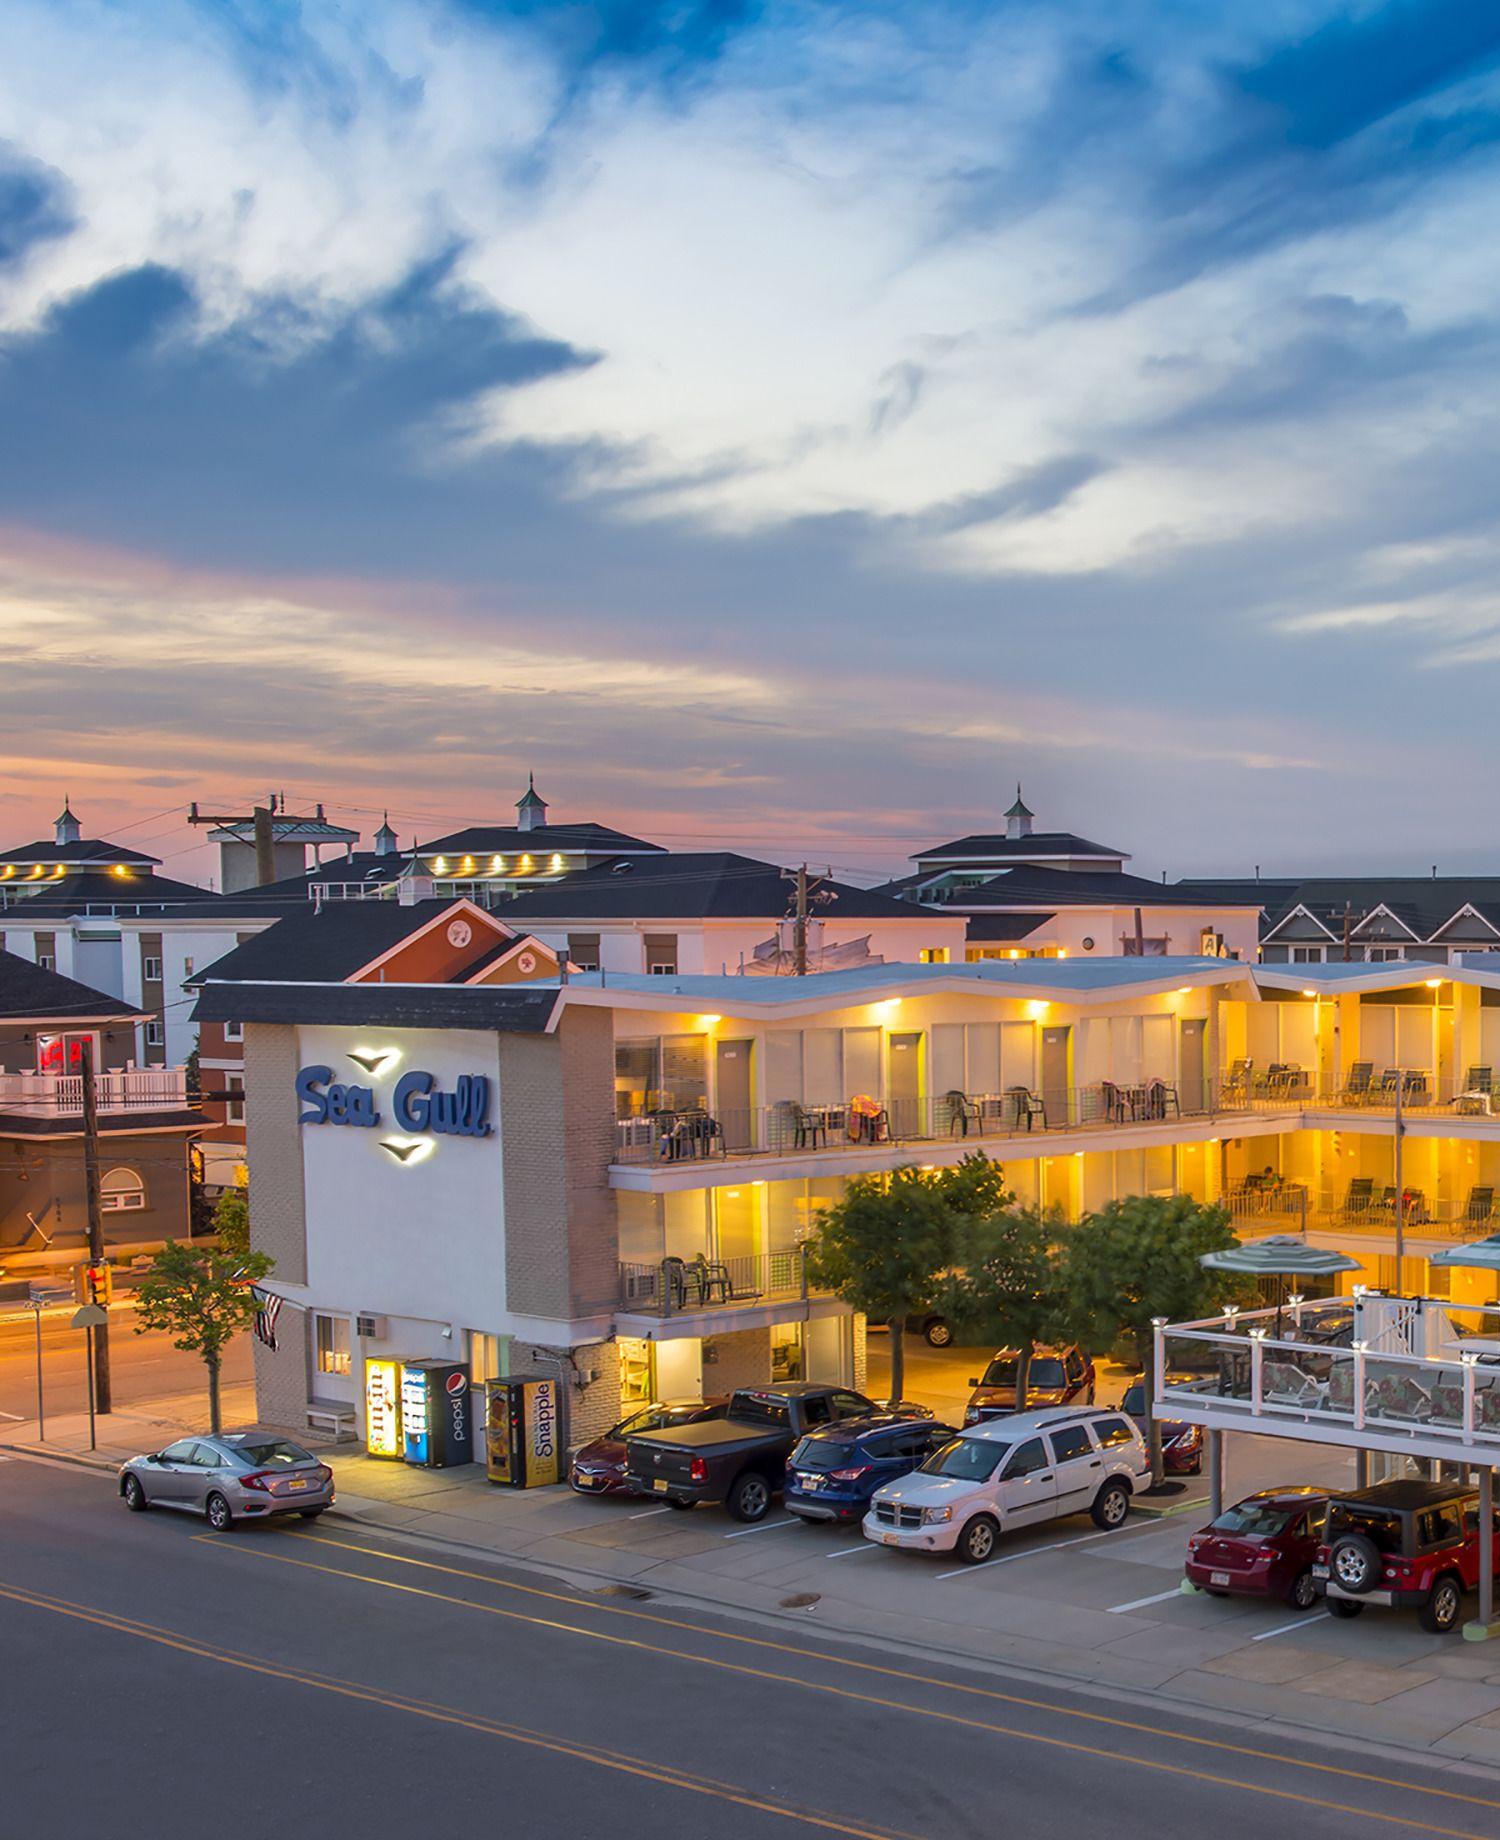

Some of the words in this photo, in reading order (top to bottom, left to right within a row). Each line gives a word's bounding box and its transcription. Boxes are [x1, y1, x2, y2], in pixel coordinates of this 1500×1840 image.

[295, 1065, 381, 1128] Sea
[393, 1071, 492, 1137] Gull
[451, 1398, 466, 1441] pepsi
[535, 1383, 554, 1457] Snapple
